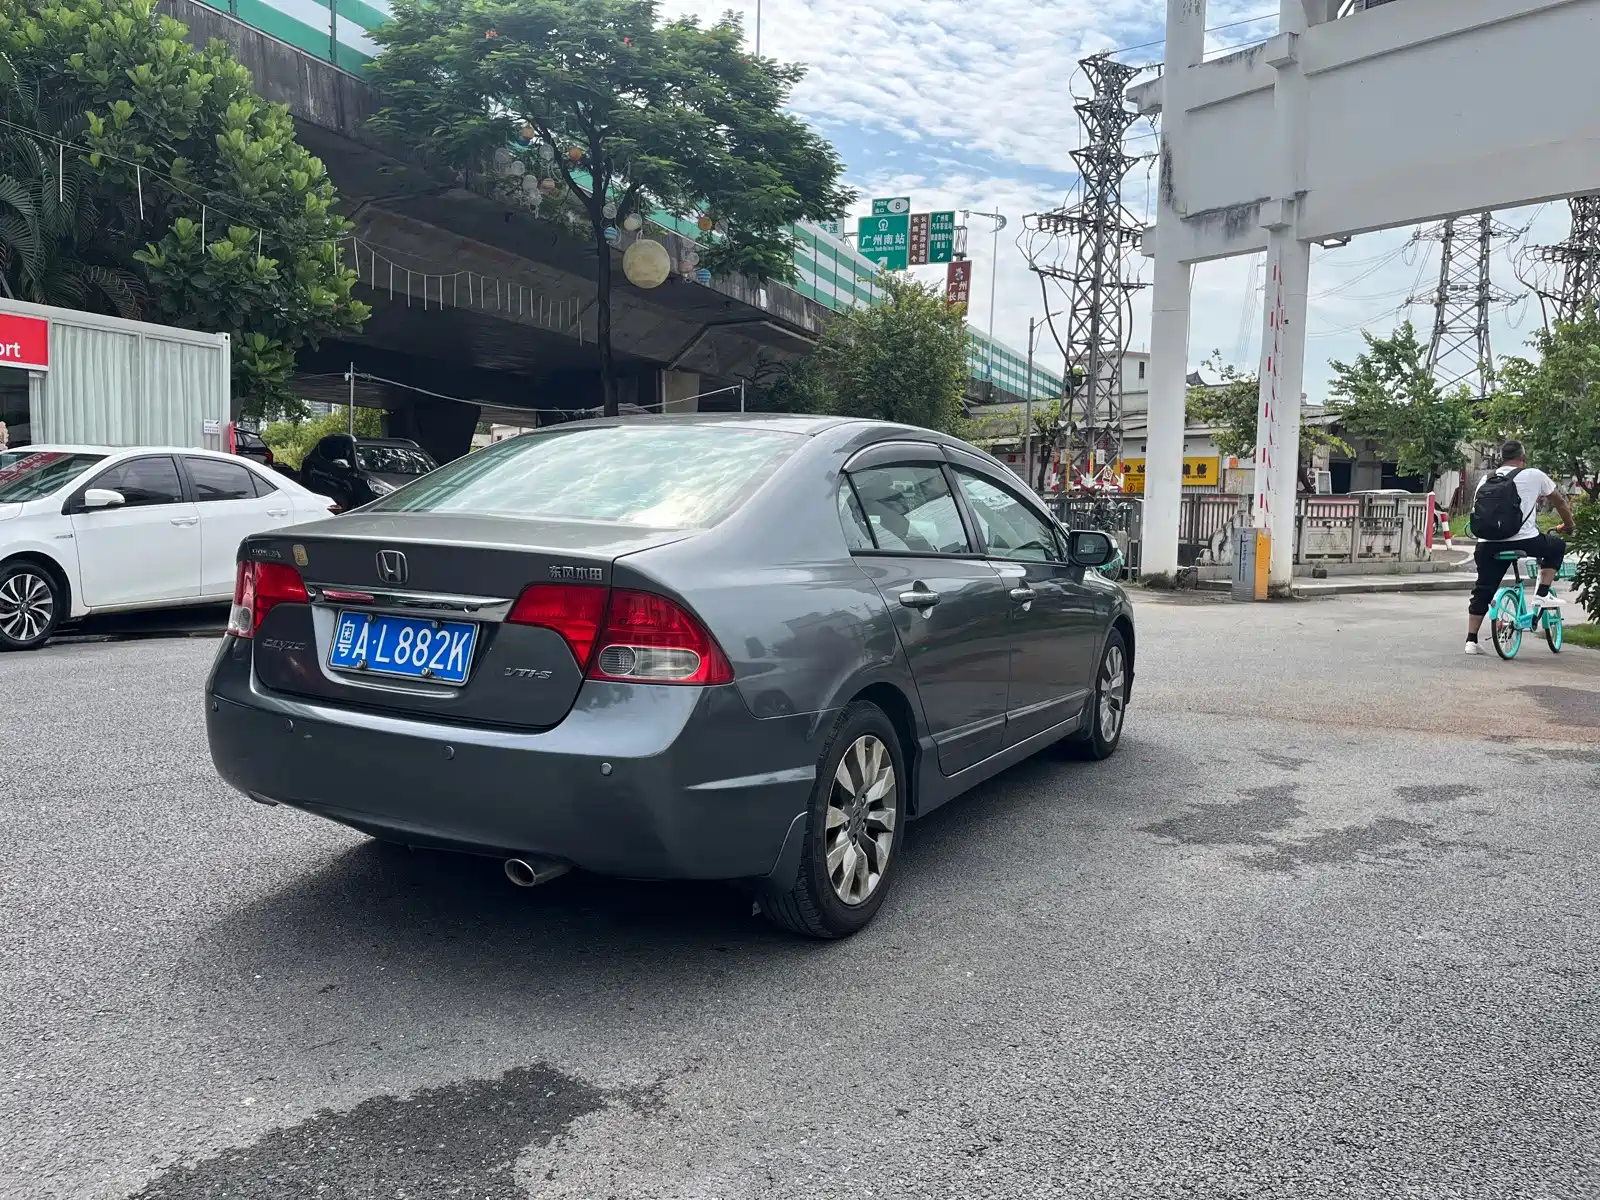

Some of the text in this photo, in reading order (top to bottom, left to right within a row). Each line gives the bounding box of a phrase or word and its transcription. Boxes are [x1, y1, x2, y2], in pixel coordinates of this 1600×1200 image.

[895, 202, 901, 210] 8
[861, 232, 906, 246] 广州南站
[948, 280, 968, 292] 广州
[548, 565, 603, 581] 东风本田
